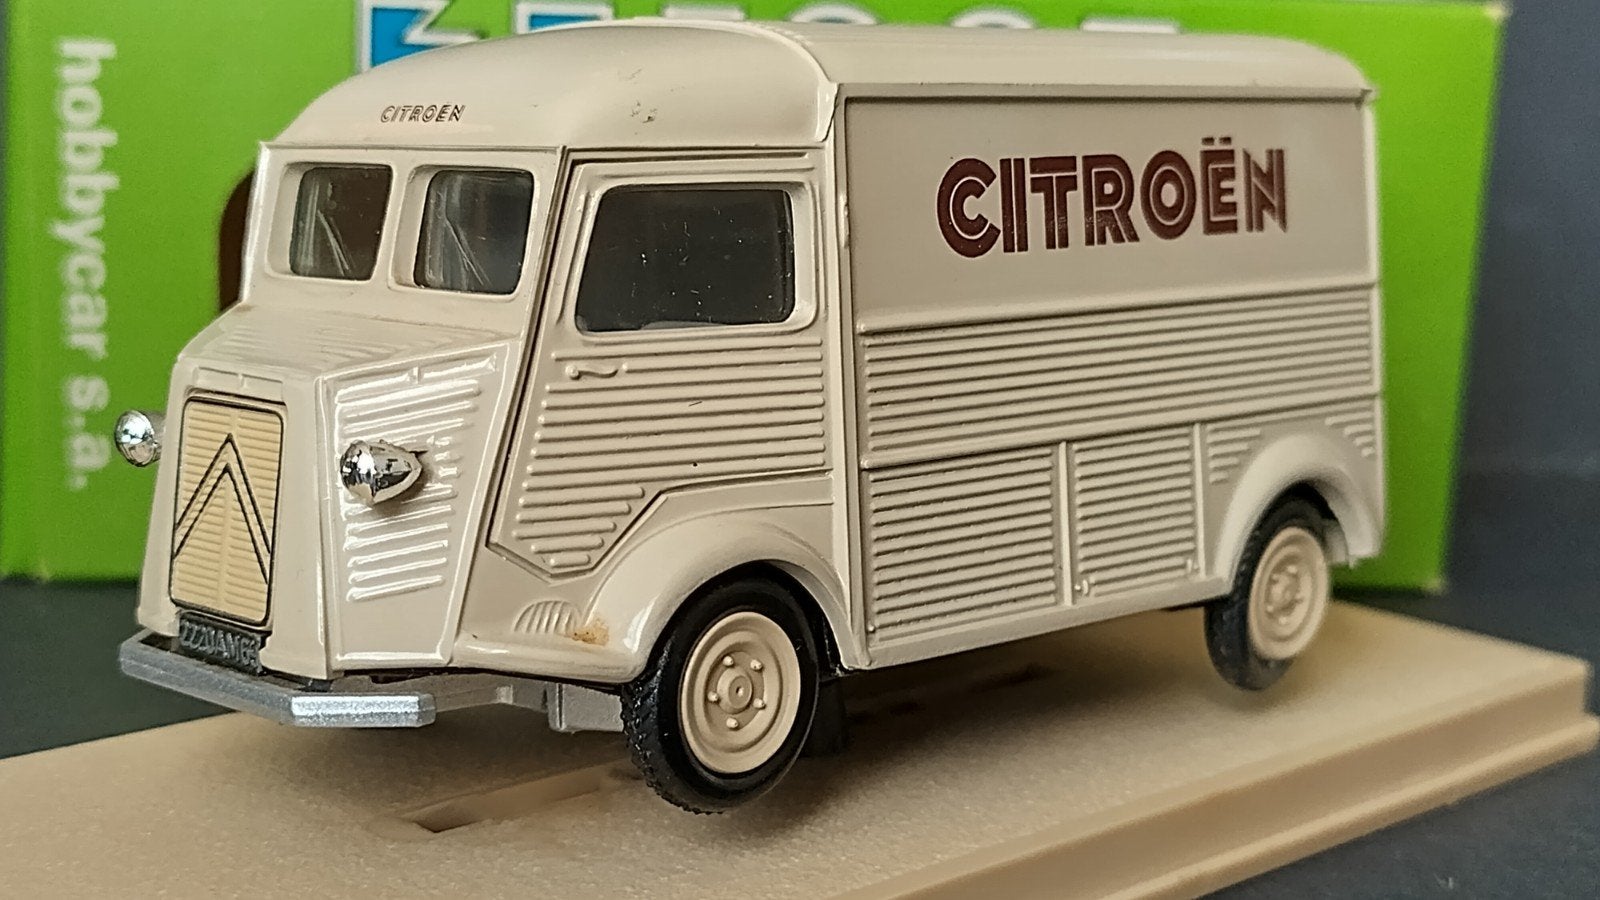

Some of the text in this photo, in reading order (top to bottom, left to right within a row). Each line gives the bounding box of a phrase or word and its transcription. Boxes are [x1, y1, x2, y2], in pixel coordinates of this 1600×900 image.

[52, 40, 119, 489] hobbycar s.a.
[937, 136, 1288, 258] CITROËN
